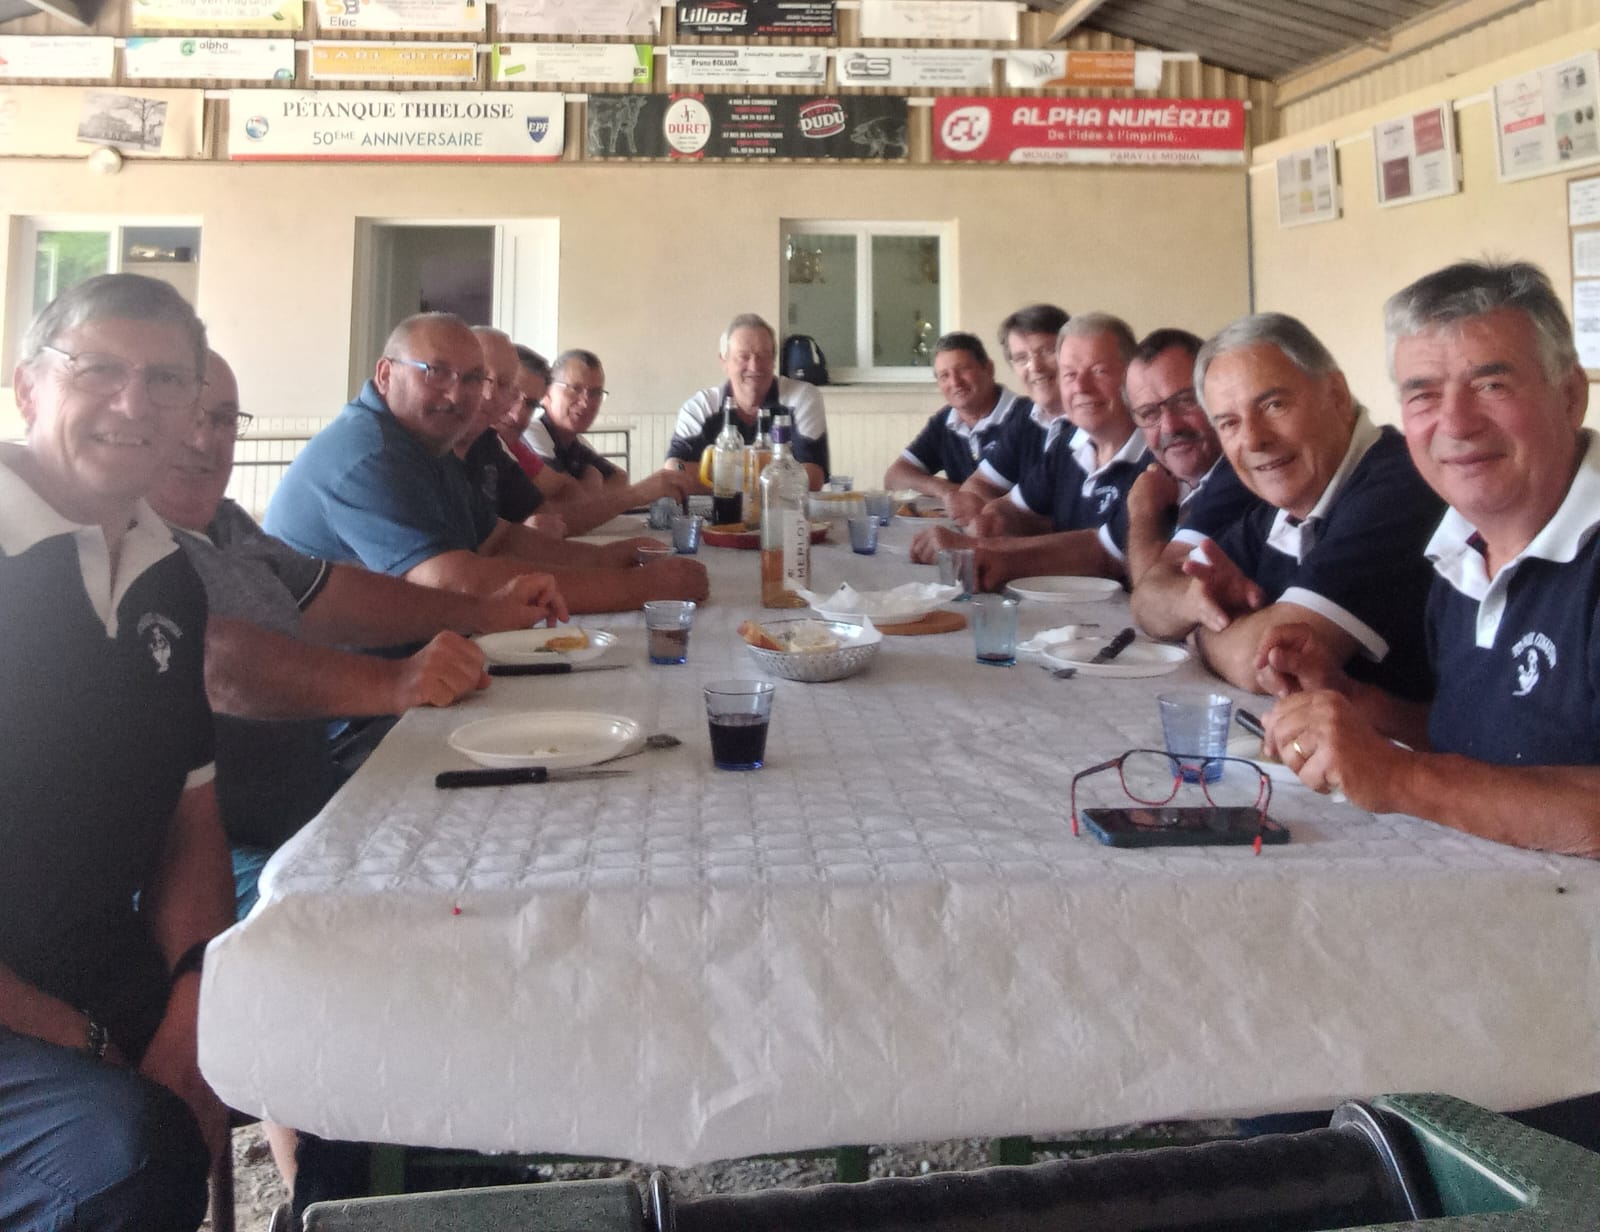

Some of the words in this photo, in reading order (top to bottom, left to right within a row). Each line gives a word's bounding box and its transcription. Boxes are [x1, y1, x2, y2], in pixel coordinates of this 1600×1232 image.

[330, 16, 357, 28] Elec
[679, 8, 748, 24] Lillocci
[200, 41, 229, 50] alpha
[283, 97, 396, 120] PÉTANQUE
[401, 103, 514, 119] THIELOISE
[1012, 107, 1101, 126] ALPHA
[1108, 104, 1231, 128] NUMÉRIQ
[668, 123, 708, 134] DURET
[361, 132, 483, 147] ANNIVERSAIRE
[1047, 130, 1064, 141] De
